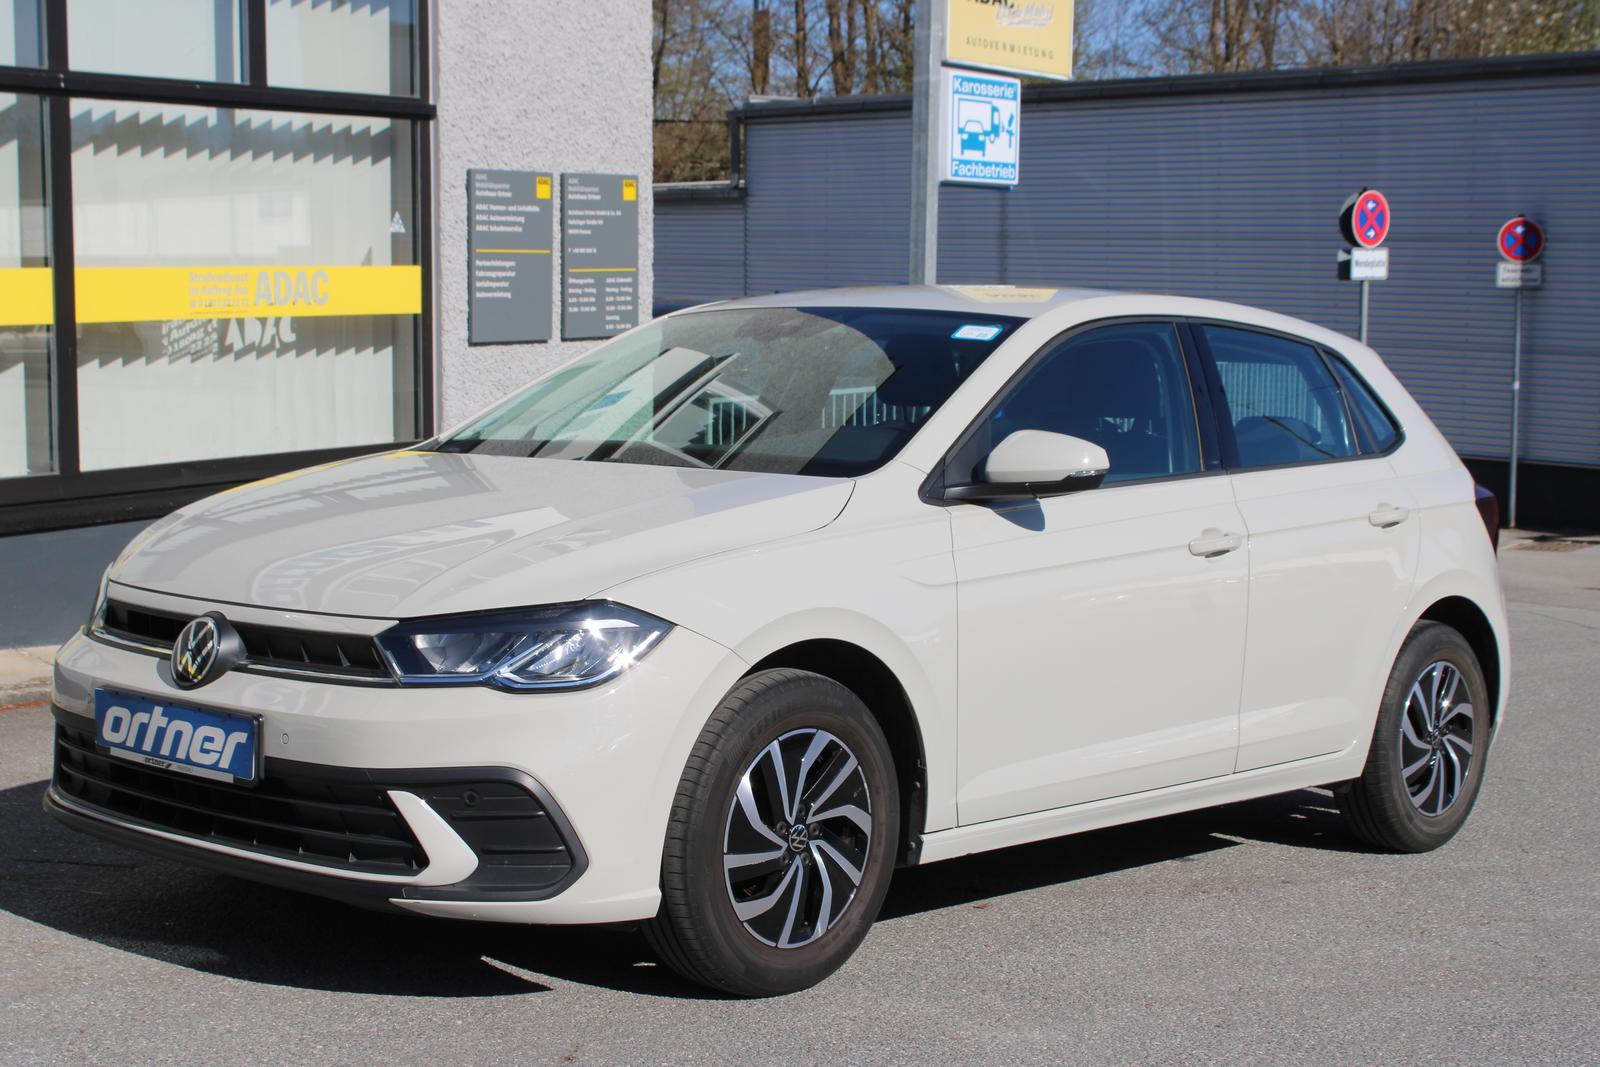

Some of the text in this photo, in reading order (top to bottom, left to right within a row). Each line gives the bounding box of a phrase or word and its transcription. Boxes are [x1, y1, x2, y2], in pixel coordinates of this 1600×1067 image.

[966, 36, 1055, 60] AUTOVERMIETUNG
[953, 77, 1015, 98] Karosserie
[952, 160, 1015, 178] Fachbetrieb
[255, 271, 330, 307] ADAC
[102, 706, 249, 769] ortner
